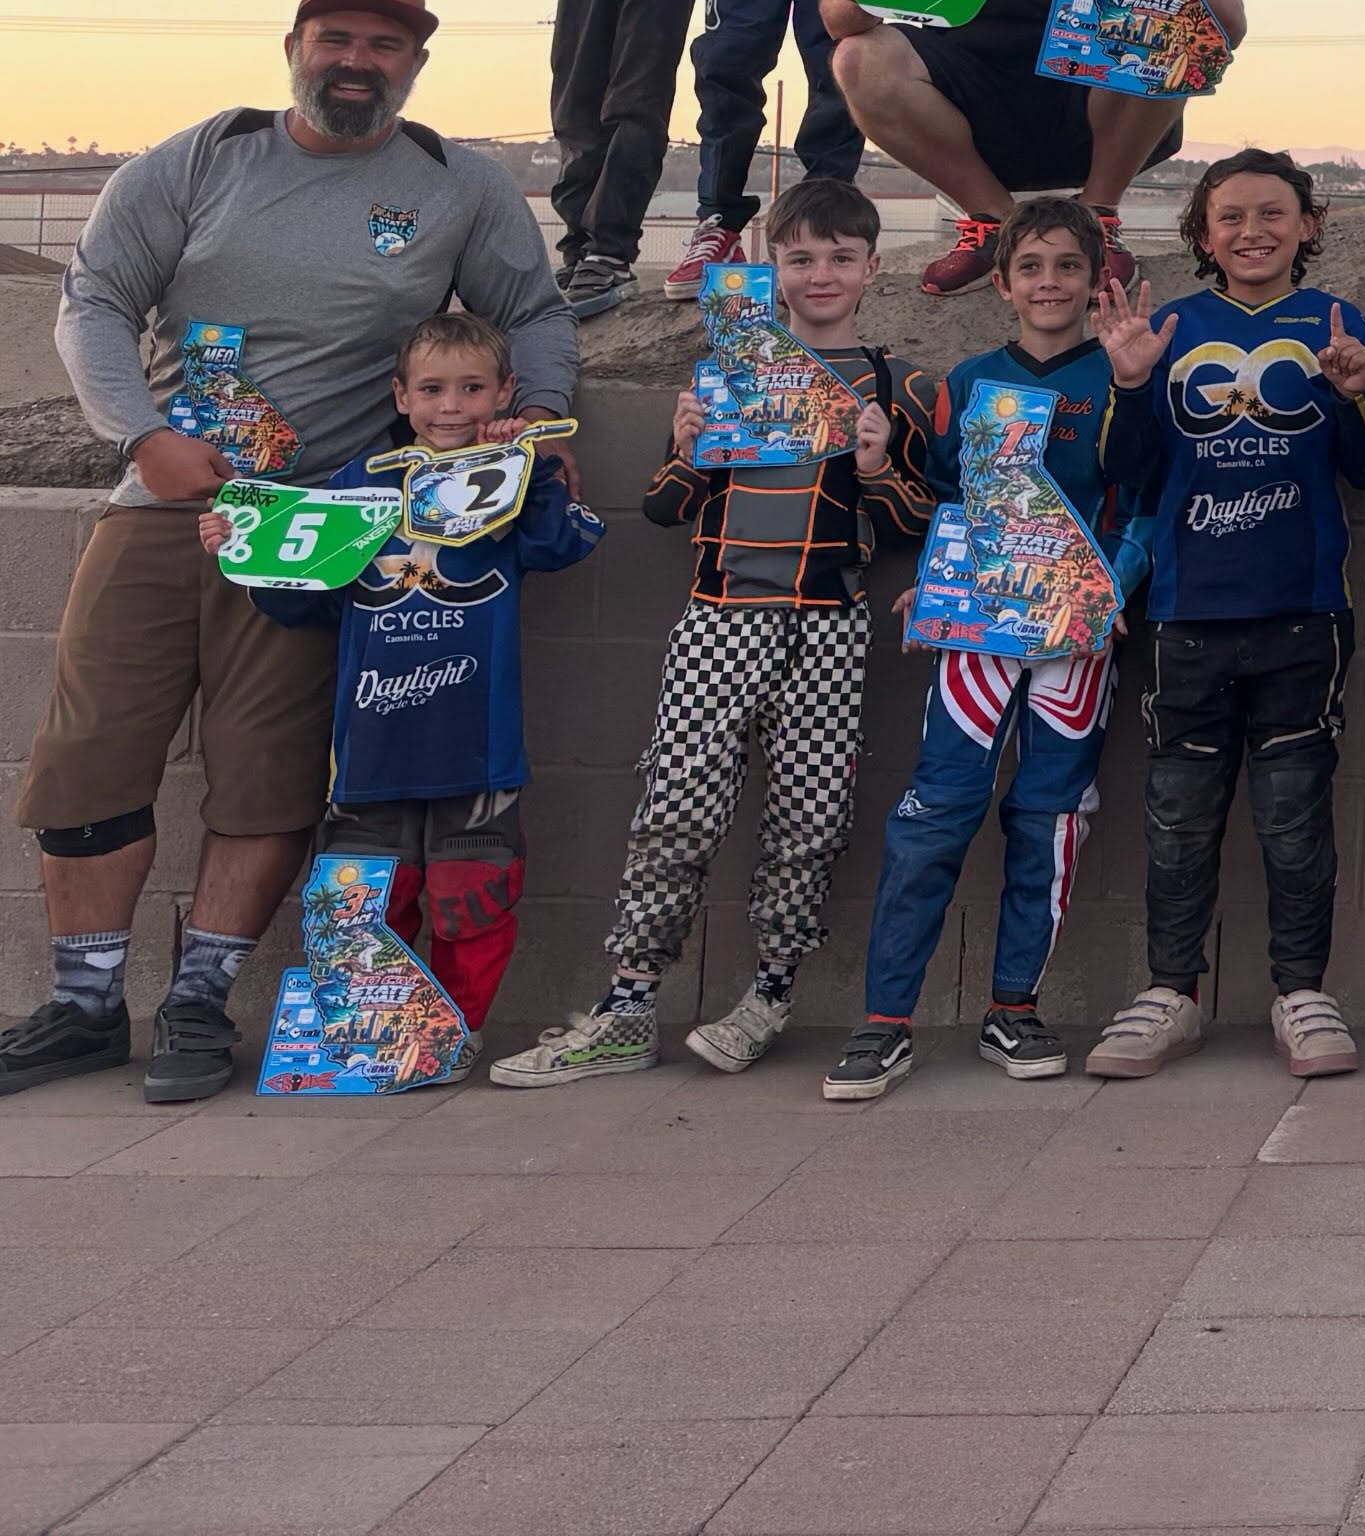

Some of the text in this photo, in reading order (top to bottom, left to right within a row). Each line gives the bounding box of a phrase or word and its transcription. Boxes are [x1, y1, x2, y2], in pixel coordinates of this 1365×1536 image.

[756, 373, 814, 385] STATE
[1168, 338, 1326, 437] GC
[997, 420, 1042, 456] 1ST
[1196, 437, 1290, 459] BICYCLES
[993, 453, 1033, 467] PLACE
[220, 491, 279, 507] CHAMP
[465, 468, 507, 512] 2
[1187, 480, 1301, 531] Daylight
[278, 513, 328, 562] 5
[1210, 522, 1238, 538] Cycle
[999, 544, 1065, 561] FINALS
[1001, 533, 1074, 553] STATE
[427, 632, 439, 641] CA
[355, 654, 478, 709] Daylight
[375, 693, 427, 715] Cycle Co
[335, 913, 374, 929] PLACE
[348, 985, 417, 999] STATE
